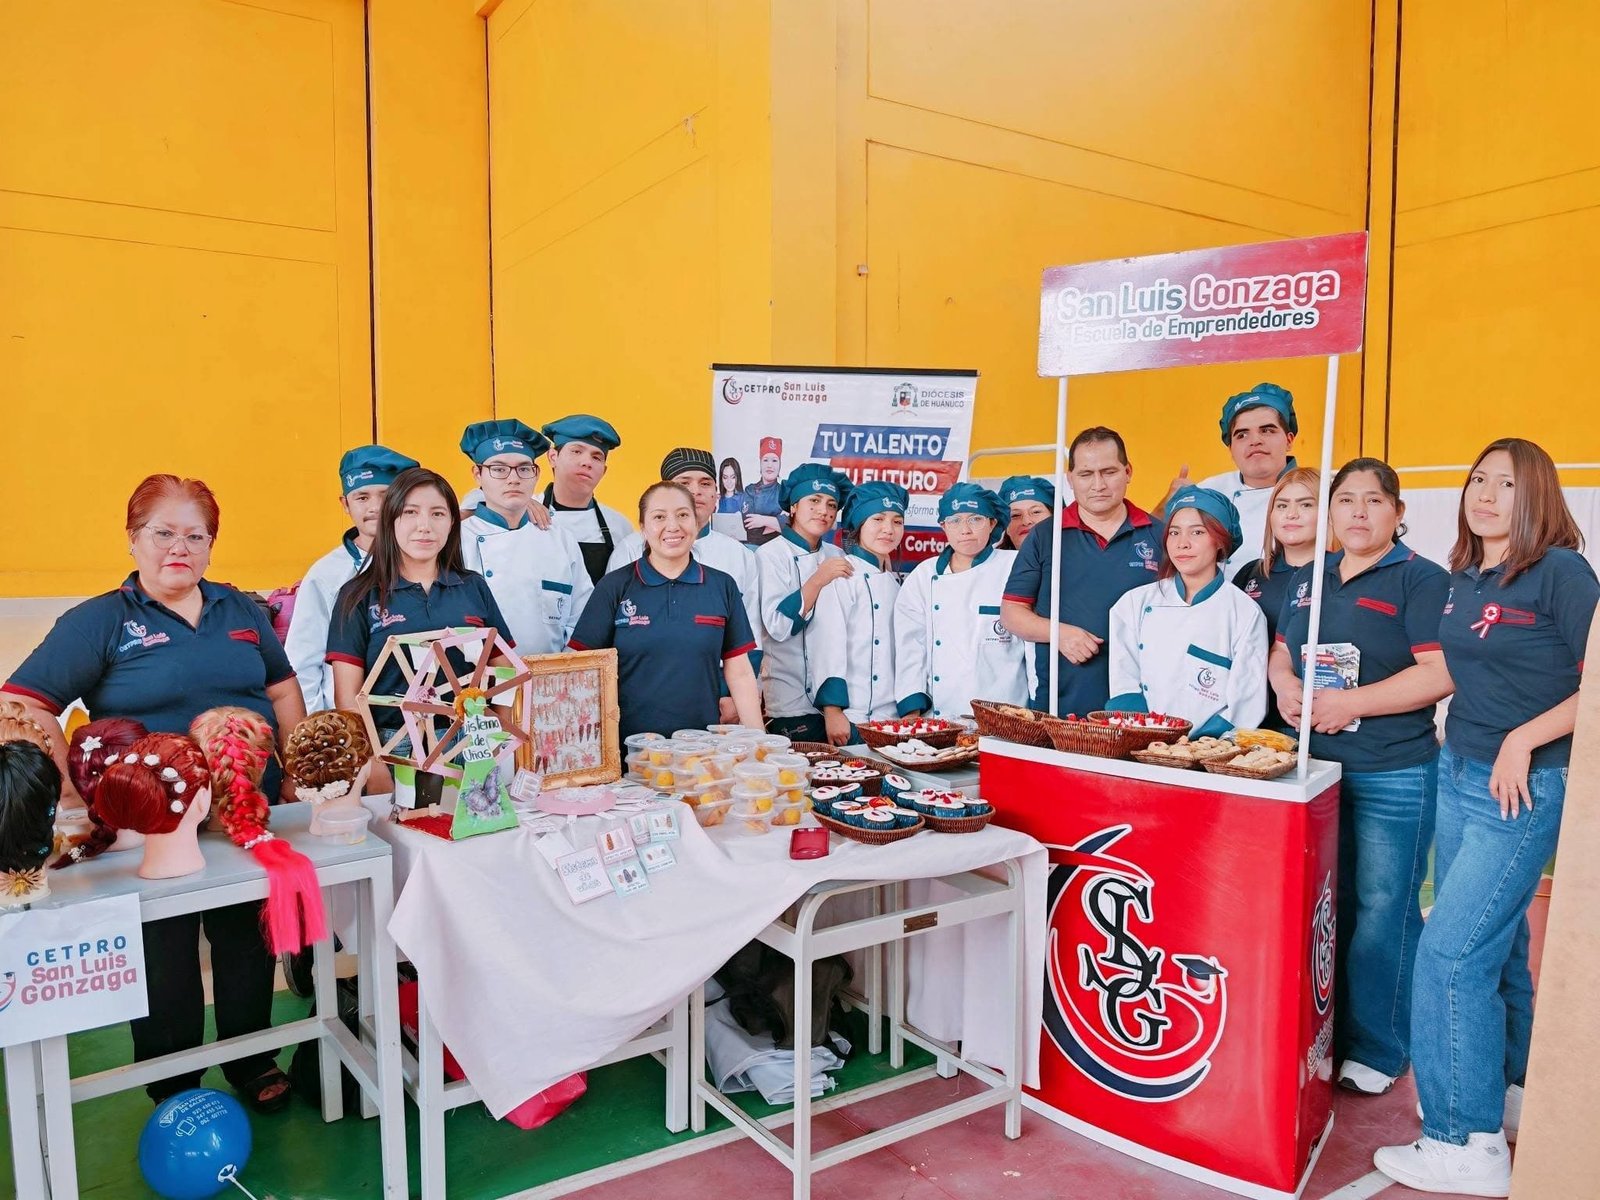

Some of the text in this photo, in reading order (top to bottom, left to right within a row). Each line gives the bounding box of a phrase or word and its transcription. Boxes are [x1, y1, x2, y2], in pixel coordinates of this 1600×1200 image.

[1059, 272, 1337, 321] San Luis Gonzaga
[1073, 308, 1316, 345] Escuela de Emprendedores
[744, 384, 780, 394] CETPRO
[781, 392, 827, 404] Gonzaga
[783, 381, 826, 391] San Luis
[920, 400, 930, 408] DE
[819, 431, 942, 456] TU TALENTO
[862, 468, 938, 492] FUTURO
[474, 733, 486, 746] de
[26, 936, 127, 966] CETPRO
[32, 952, 127, 984] San Luis
[21, 968, 137, 1005] Gonzaga
